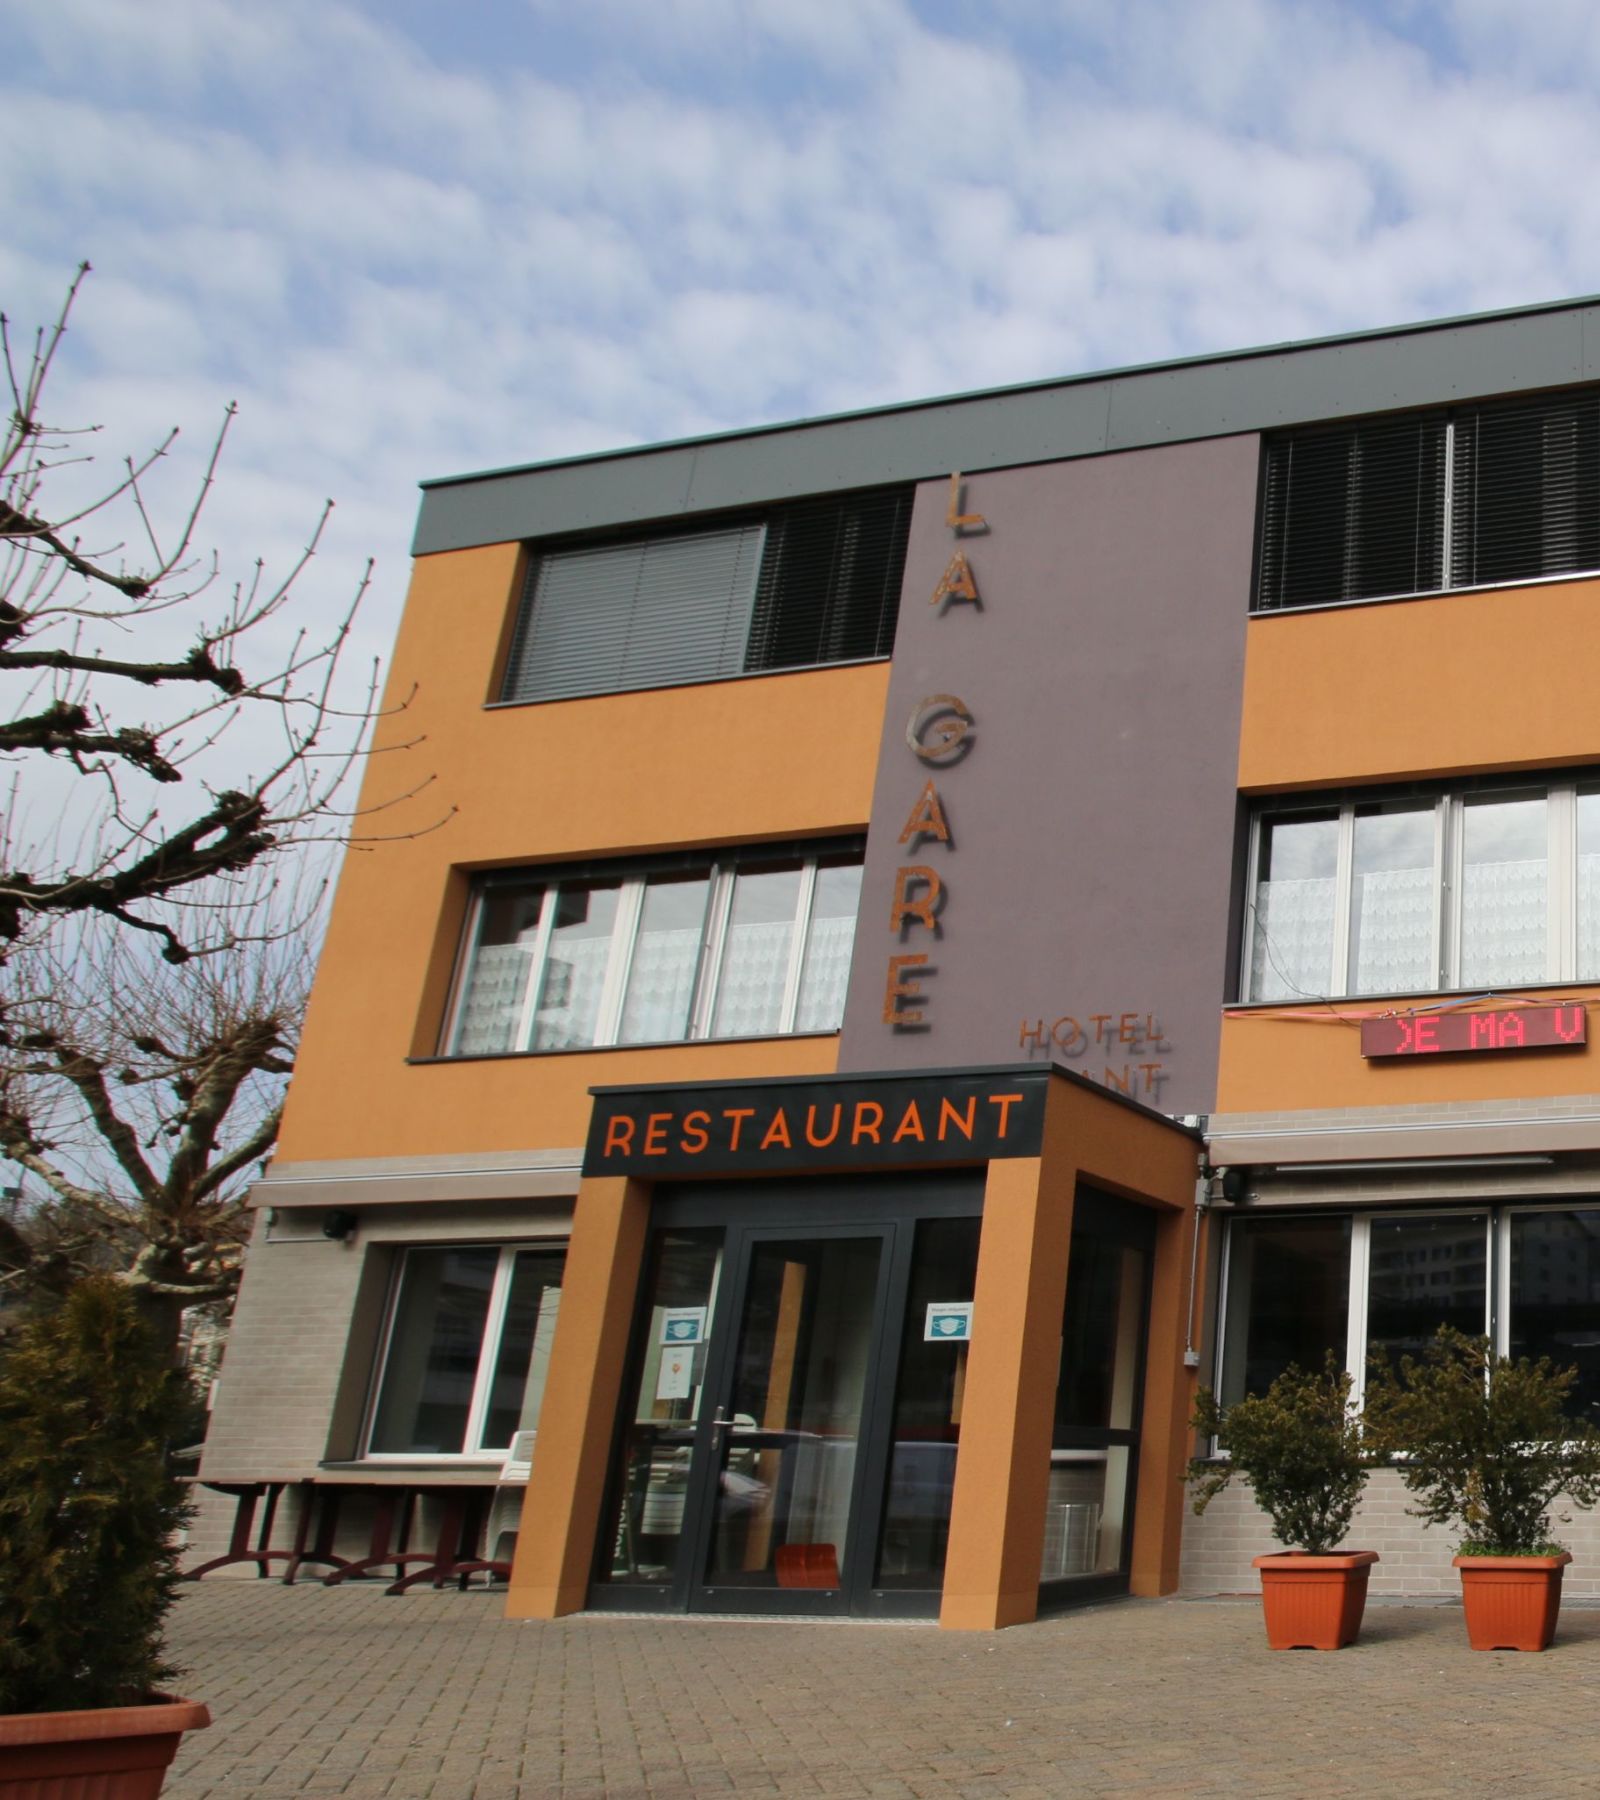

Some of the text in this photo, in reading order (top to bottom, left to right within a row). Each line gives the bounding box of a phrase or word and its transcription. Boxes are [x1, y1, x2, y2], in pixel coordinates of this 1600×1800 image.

[882, 471, 986, 1024] LA GARE
[1019, 1012, 1164, 1048] HOTEL
[1471, 1012, 1524, 1048] MA
[603, 1094, 1023, 1157] RESTAURANT
